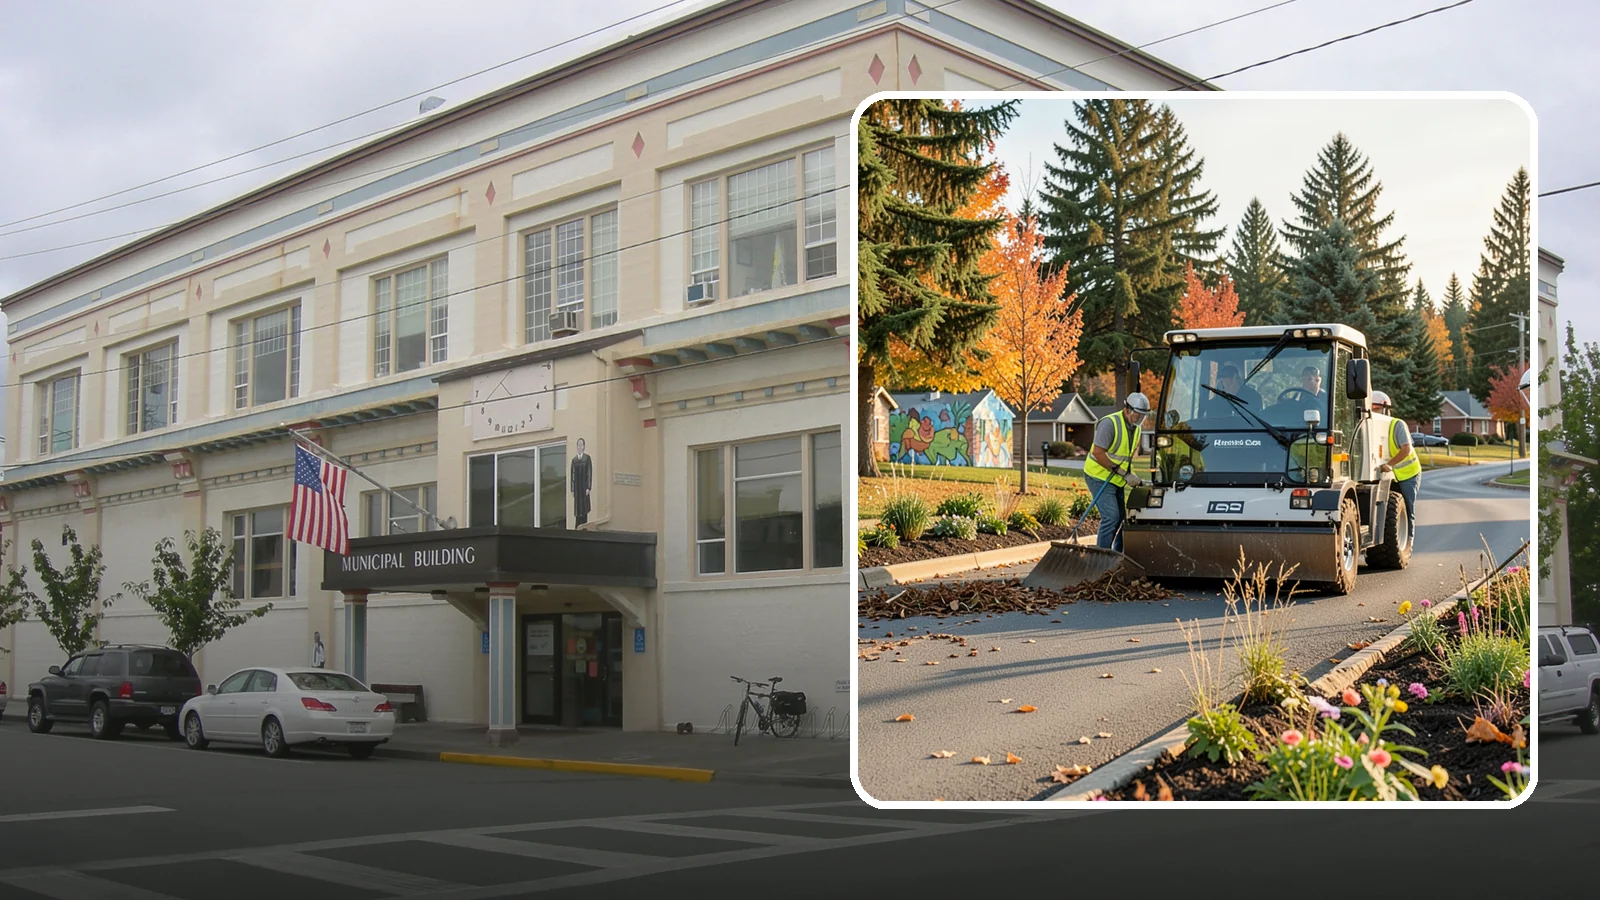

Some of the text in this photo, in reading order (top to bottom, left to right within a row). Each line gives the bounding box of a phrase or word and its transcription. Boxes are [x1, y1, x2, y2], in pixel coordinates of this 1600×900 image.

[494, 424, 500, 432] 10
[507, 425, 513, 433] 12
[342, 547, 475, 572] MUNICIPAL BUILDING
